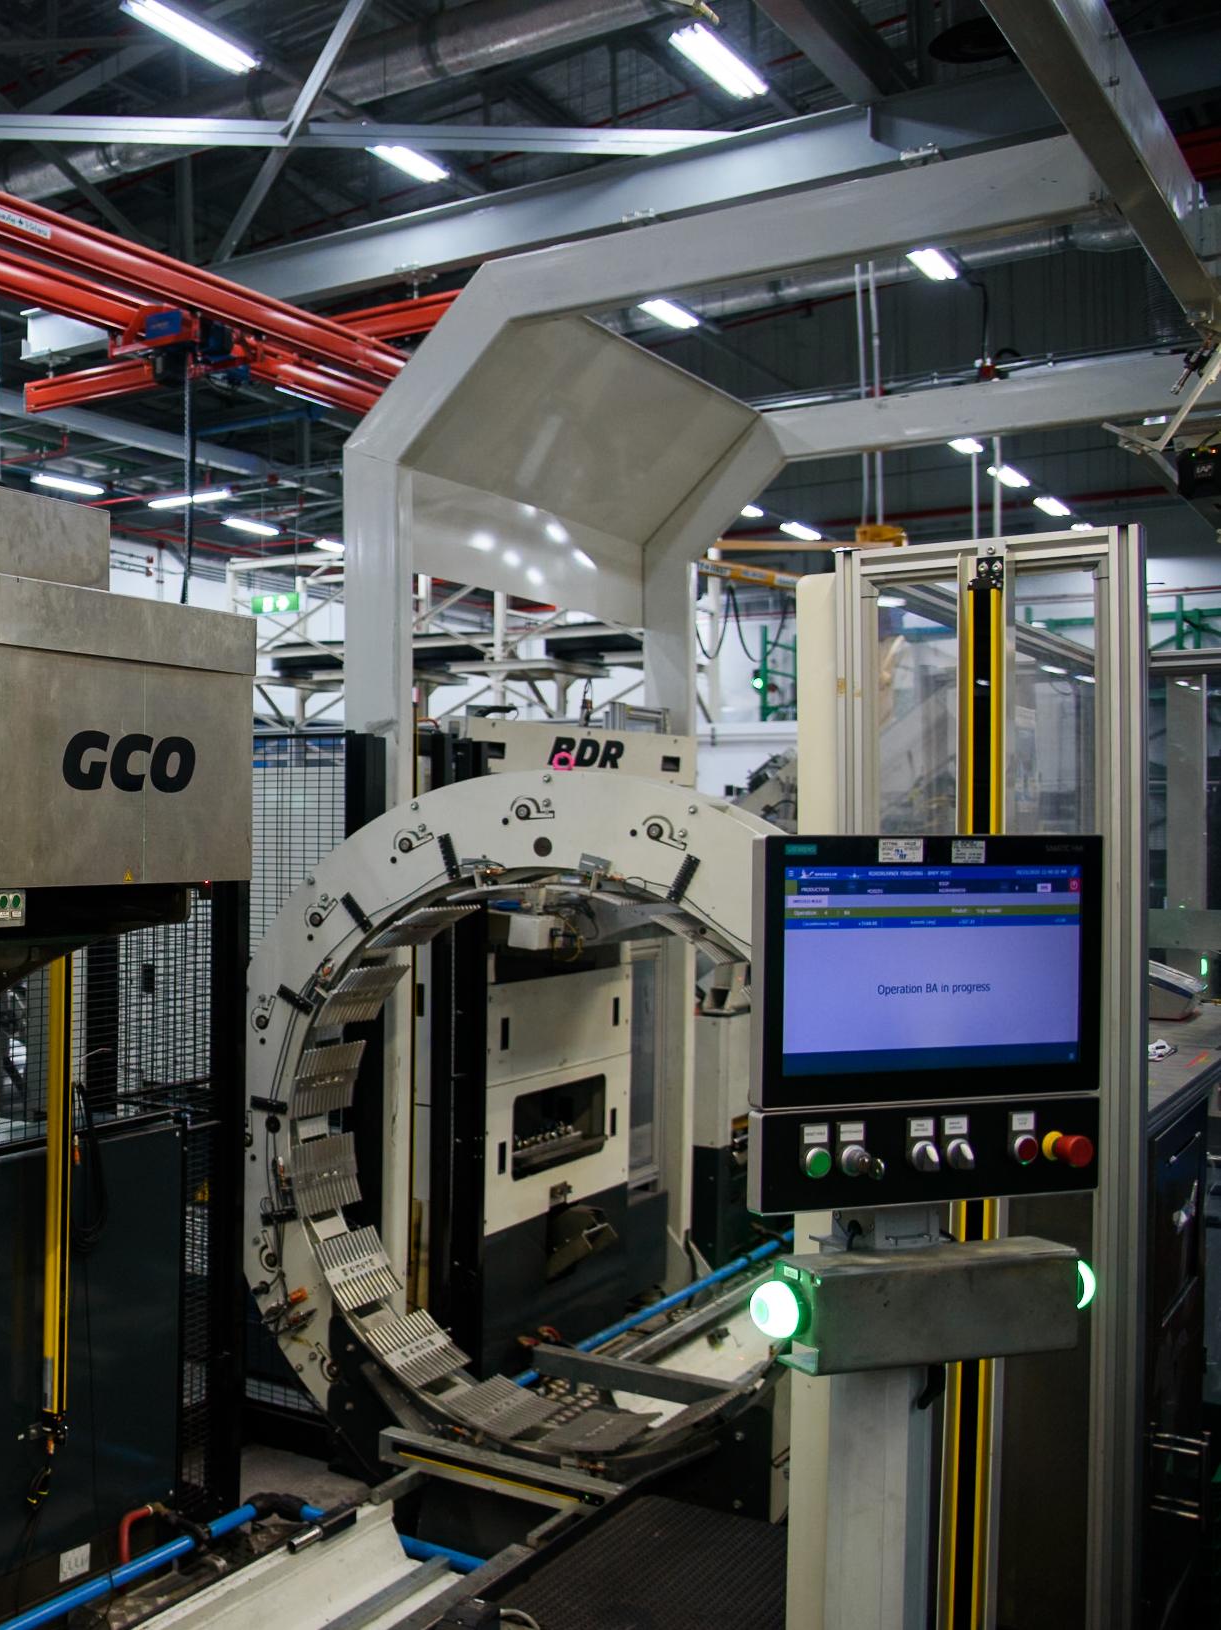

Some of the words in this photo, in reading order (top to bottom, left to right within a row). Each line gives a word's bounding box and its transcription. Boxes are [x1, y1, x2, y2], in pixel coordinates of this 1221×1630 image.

[62, 729, 196, 794] GCO
[877, 984, 922, 996] Operation
[925, 983, 938, 993] BA
[941, 983, 949, 992] in
[952, 983, 991, 995] progress
